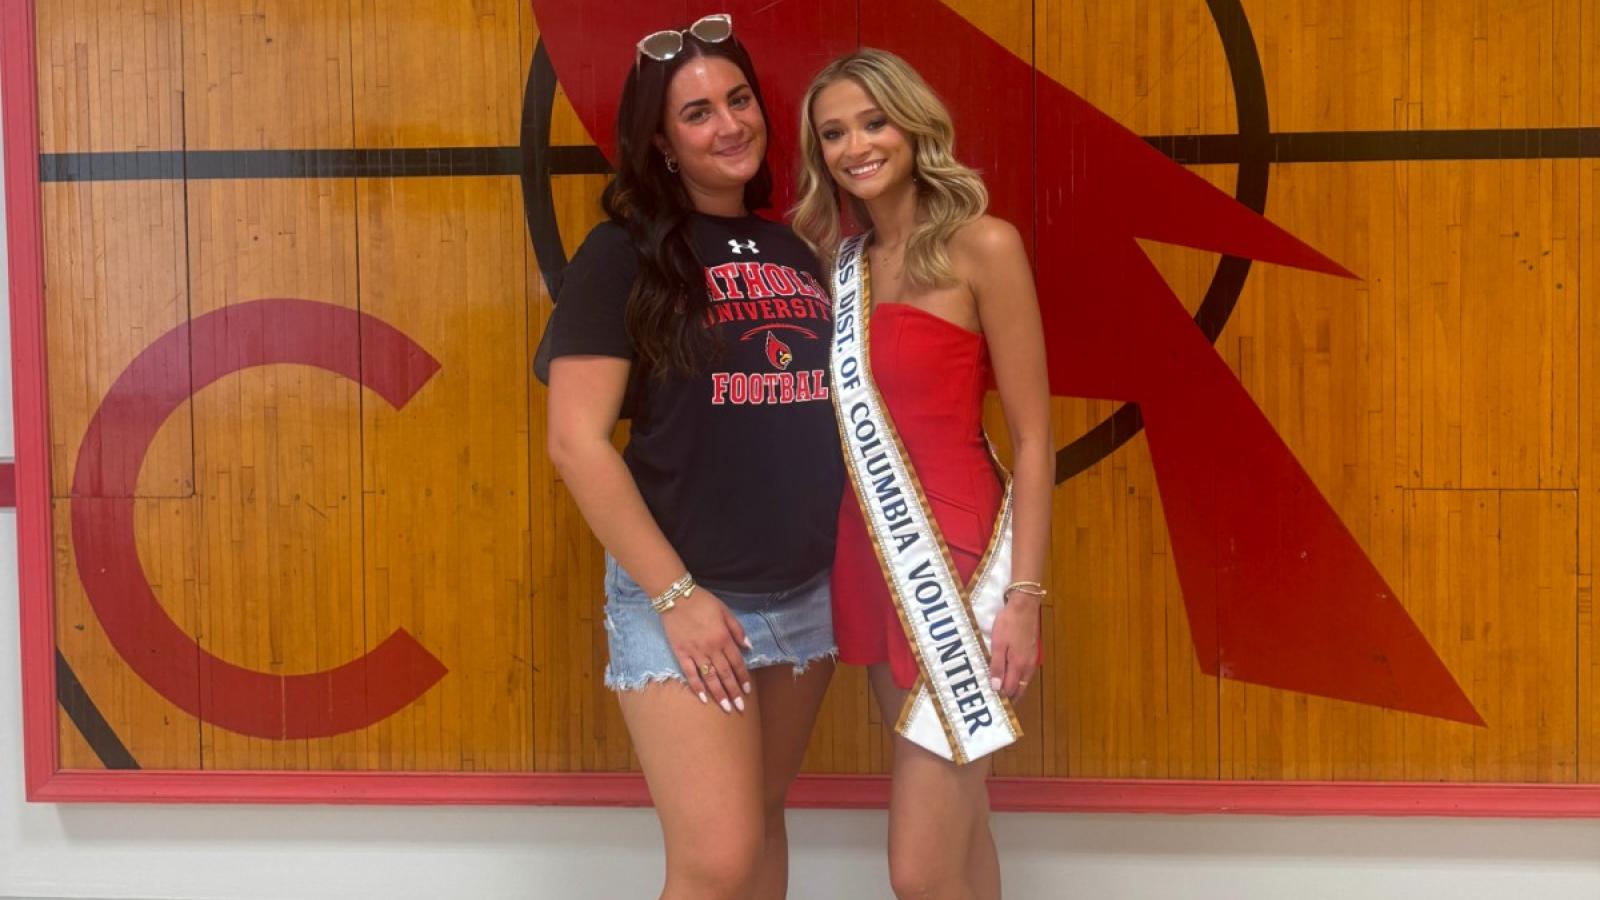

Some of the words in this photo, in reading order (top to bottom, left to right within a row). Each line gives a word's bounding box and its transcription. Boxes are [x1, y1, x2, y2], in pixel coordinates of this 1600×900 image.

[702, 298, 831, 329] UNIVERSIT
[836, 291, 857, 353] DIST.
[711, 369, 829, 405] FOOTBAL
[840, 356, 861, 390] OF
[850, 401, 921, 554] COLUMBIA
[71, 298, 449, 740] C
[908, 560, 993, 737] VOLUNTEER
